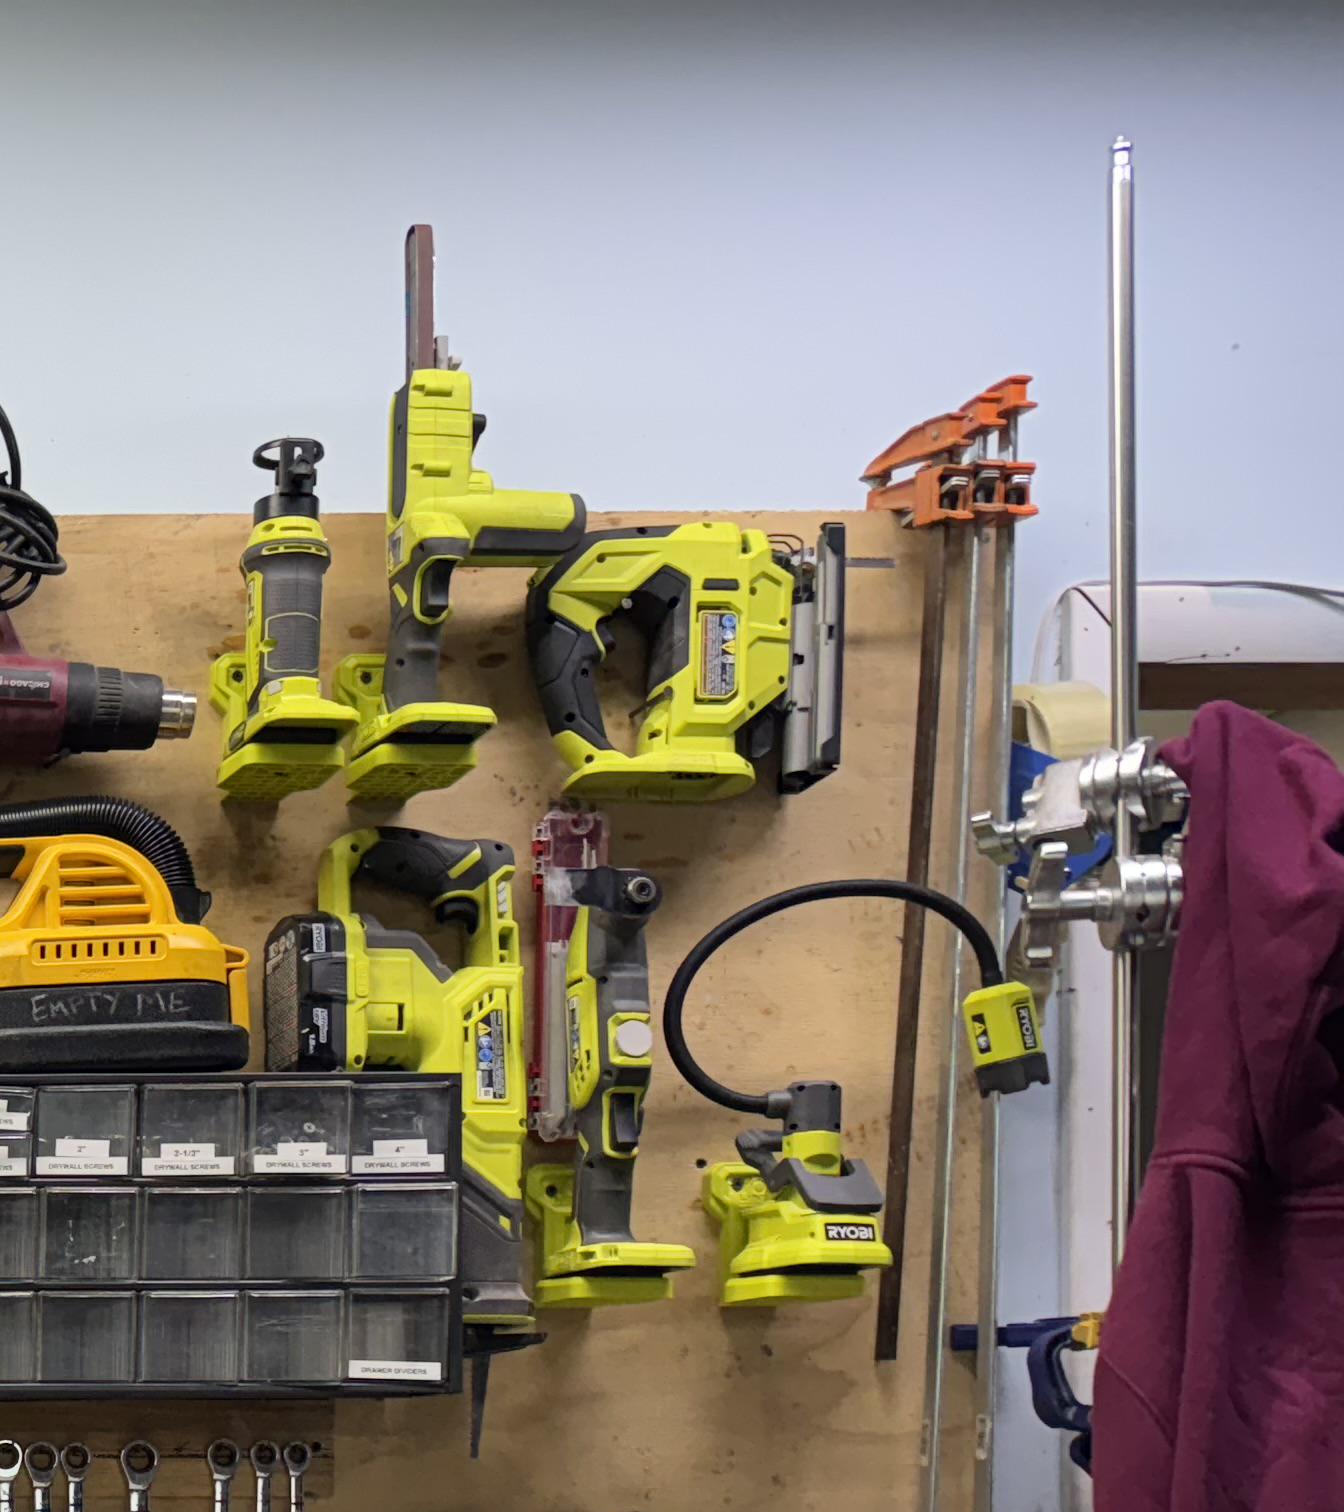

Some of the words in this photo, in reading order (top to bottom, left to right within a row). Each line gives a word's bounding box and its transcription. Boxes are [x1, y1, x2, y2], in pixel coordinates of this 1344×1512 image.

[9, 679, 50, 689] CHICAGO
[31, 993, 118, 1023] EMPTY
[136, 990, 192, 1015] ME
[1016, 1007, 1033, 1048] RYOBI
[826, 1226, 874, 1240] RYOBI
